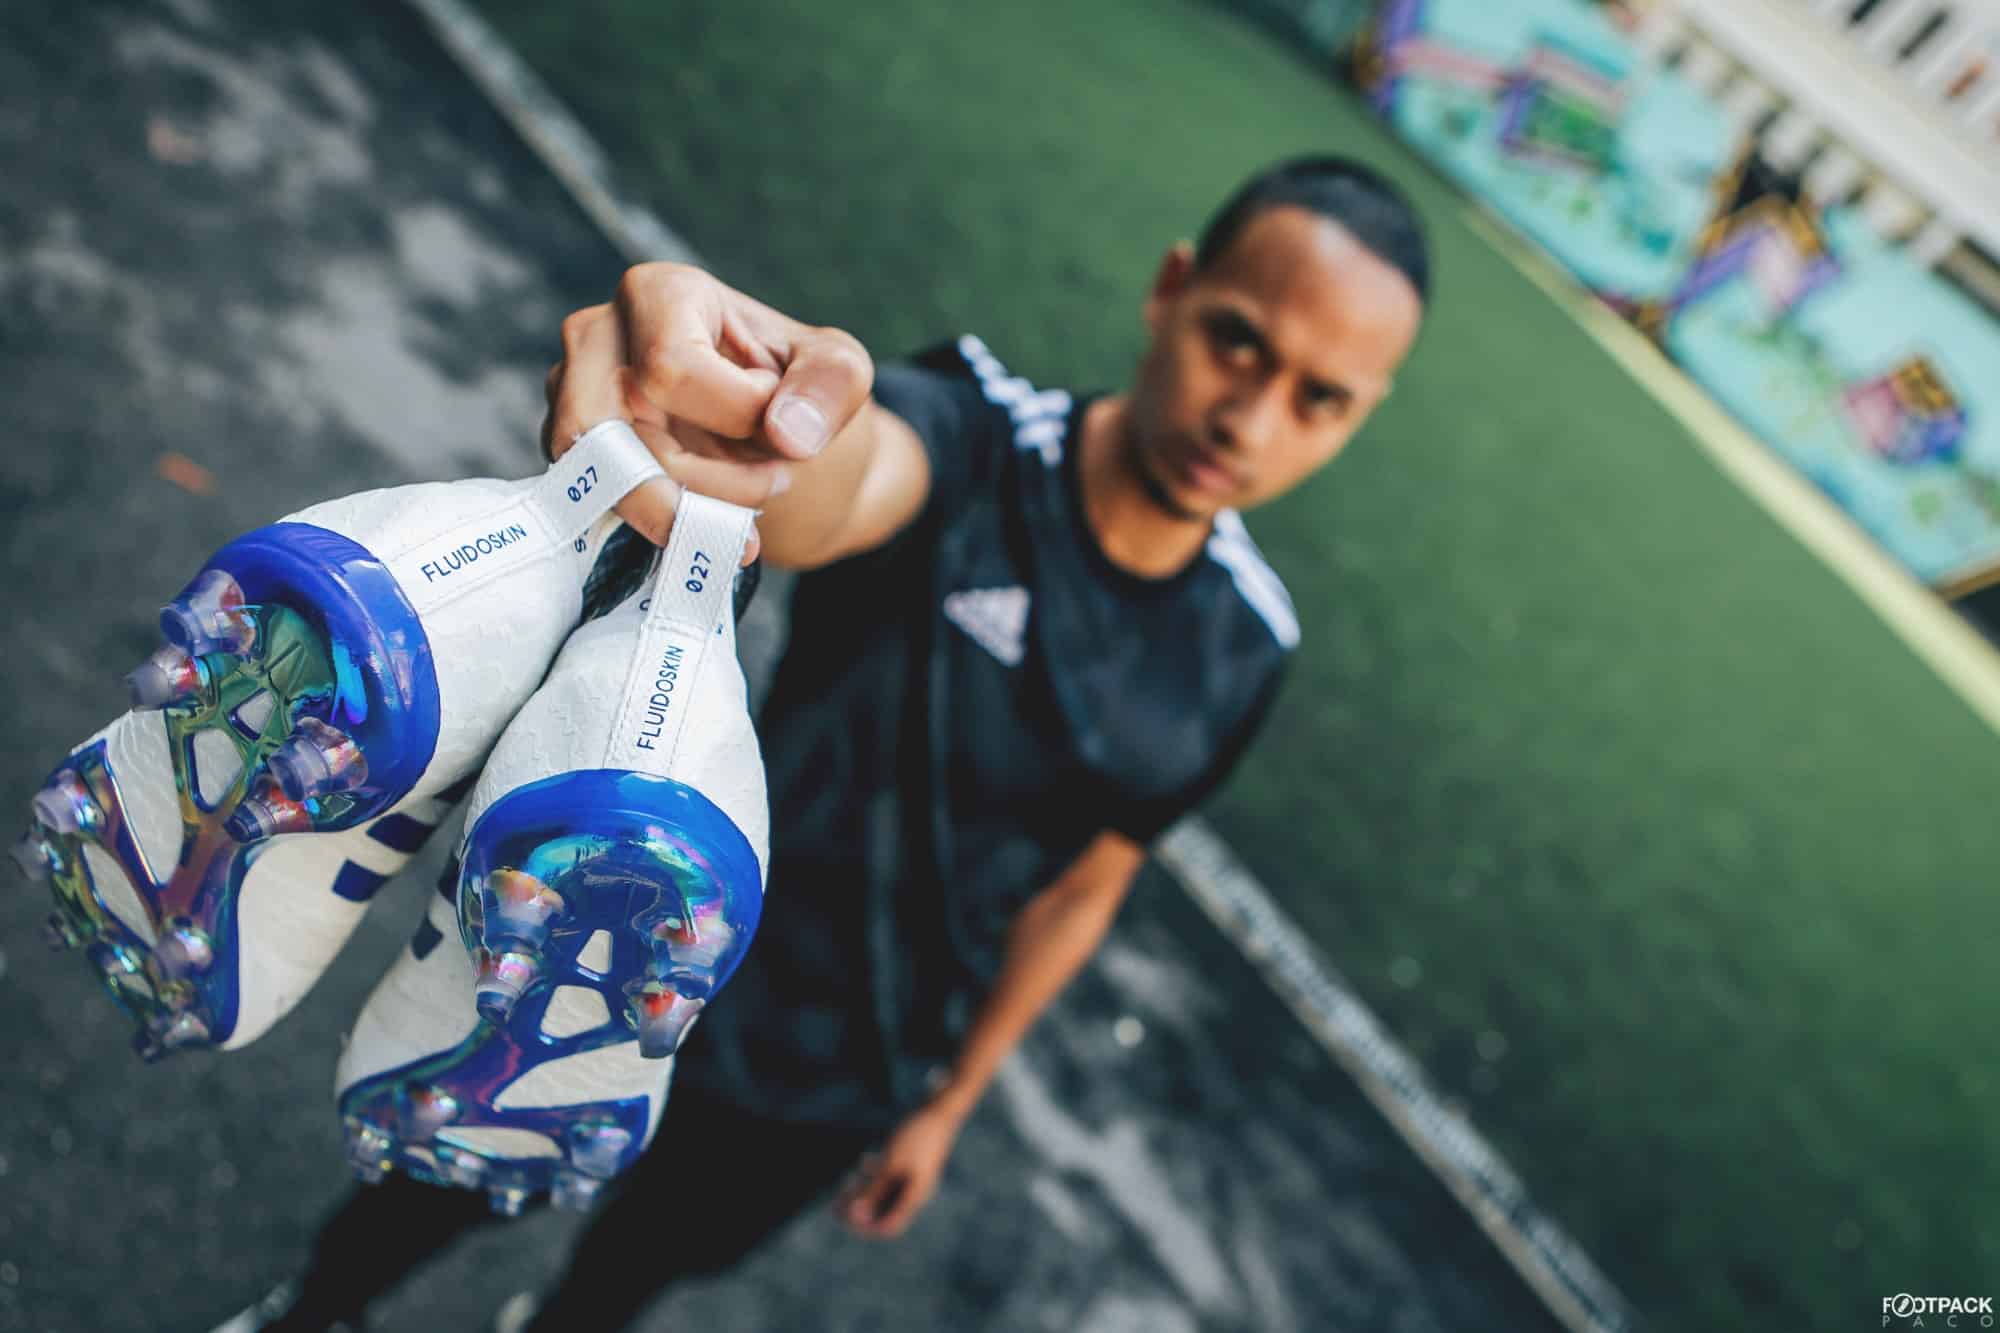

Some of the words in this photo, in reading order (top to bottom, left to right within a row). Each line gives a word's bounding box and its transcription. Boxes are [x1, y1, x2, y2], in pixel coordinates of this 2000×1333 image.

[567, 465, 599, 503] 027
[420, 522, 527, 582] FLUIDOSKIN
[686, 551, 712, 593] 027
[636, 645, 684, 750] FLUIDOSKIN
